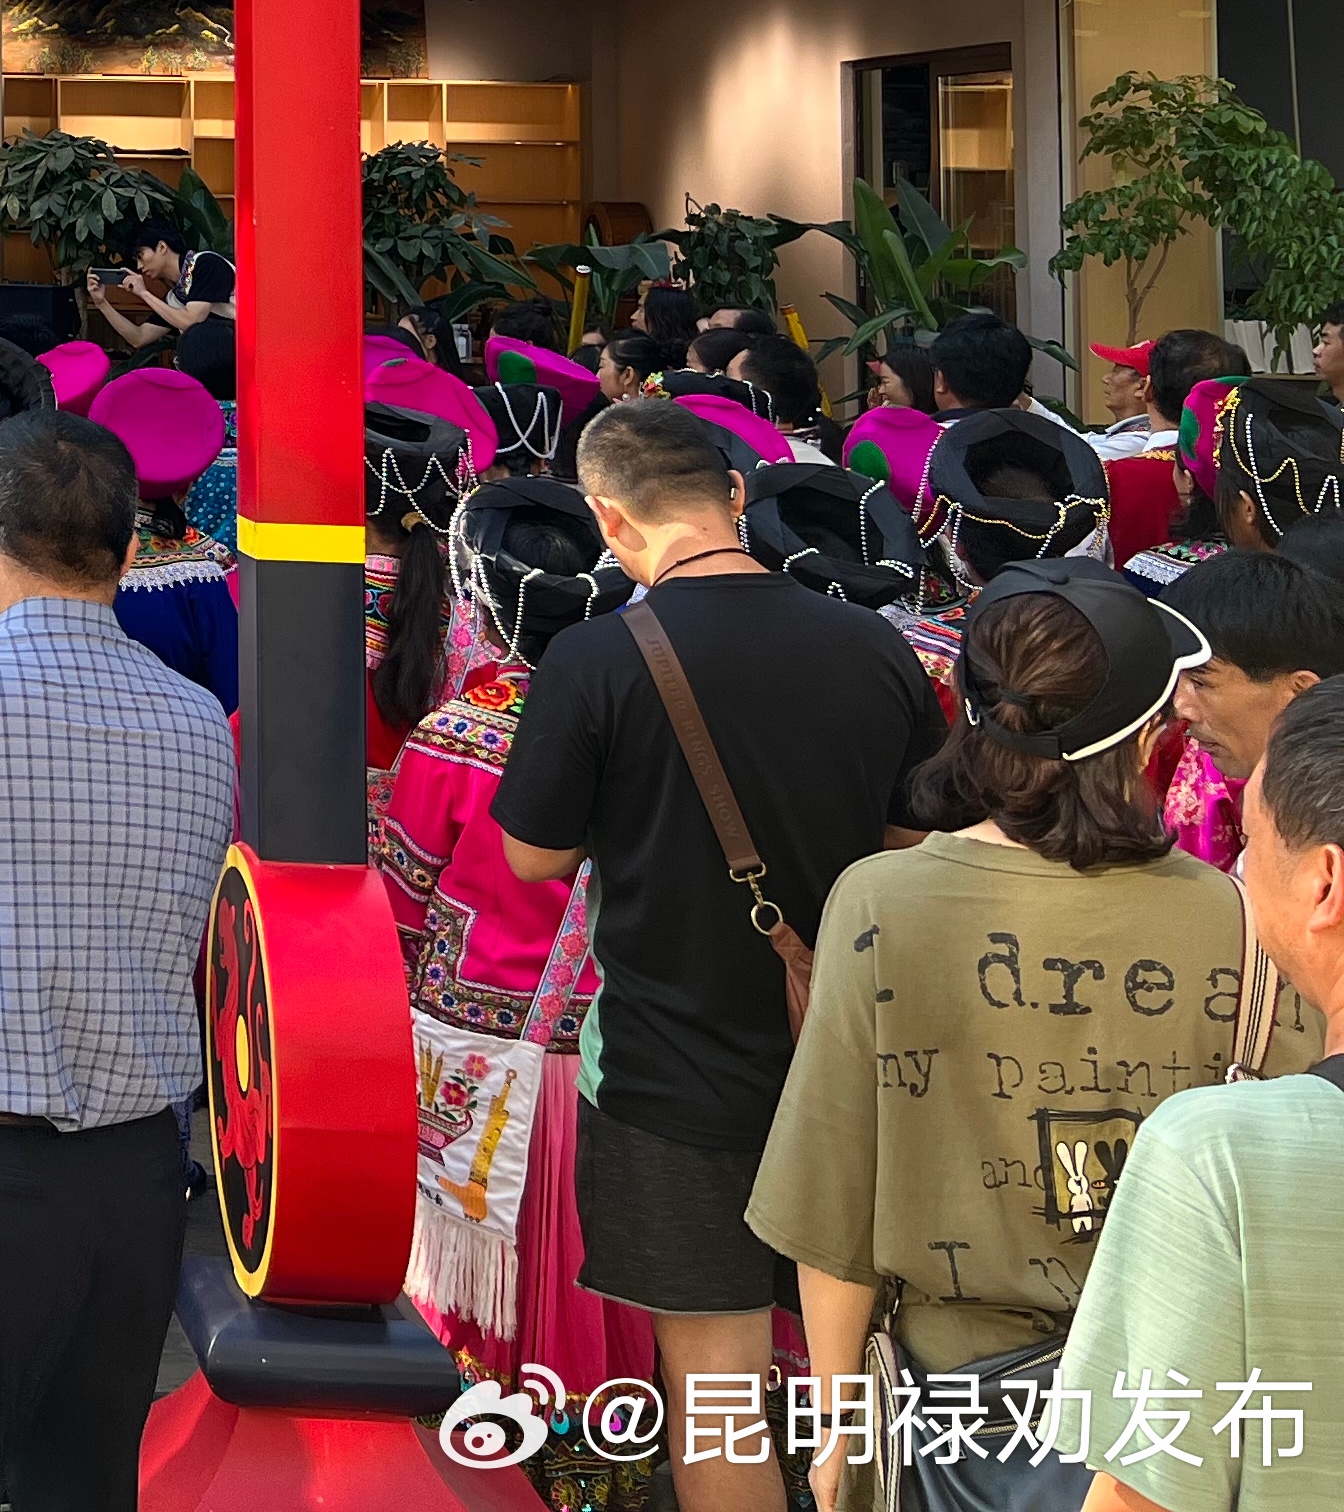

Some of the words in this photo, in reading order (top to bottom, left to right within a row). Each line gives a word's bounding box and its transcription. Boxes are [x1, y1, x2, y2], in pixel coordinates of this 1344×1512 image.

[681, 720, 714, 776] RINGS
[709, 783, 741, 838] SHOW
[978, 932, 1305, 1033] drea
[986, 1046, 1223, 1099] painti
